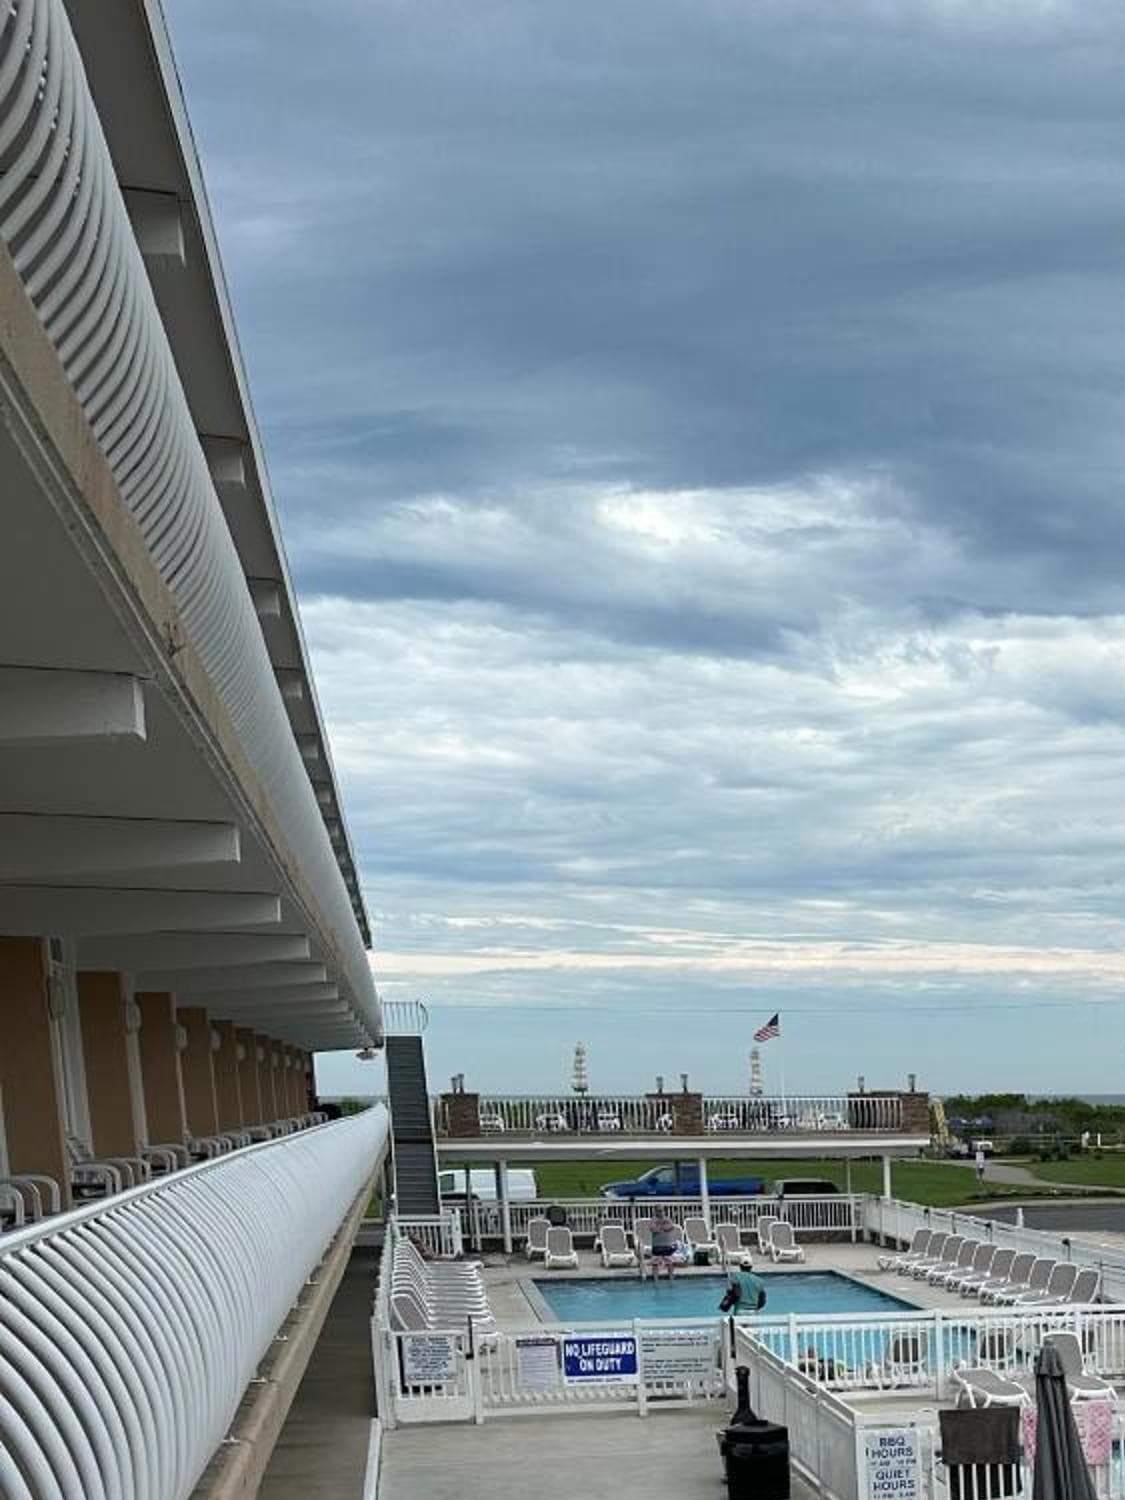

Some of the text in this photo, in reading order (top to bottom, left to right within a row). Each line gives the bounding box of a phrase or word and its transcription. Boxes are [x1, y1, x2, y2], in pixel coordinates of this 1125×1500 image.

[565, 1343, 580, 1357] NO
[582, 1341, 635, 1356] LIFEGUARD
[579, 1357, 622, 1371] ON DUTY
[871, 1447, 913, 1458] HOURS
[875, 1469, 911, 1480] QUIET
[873, 1480, 915, 1491] HOURS
